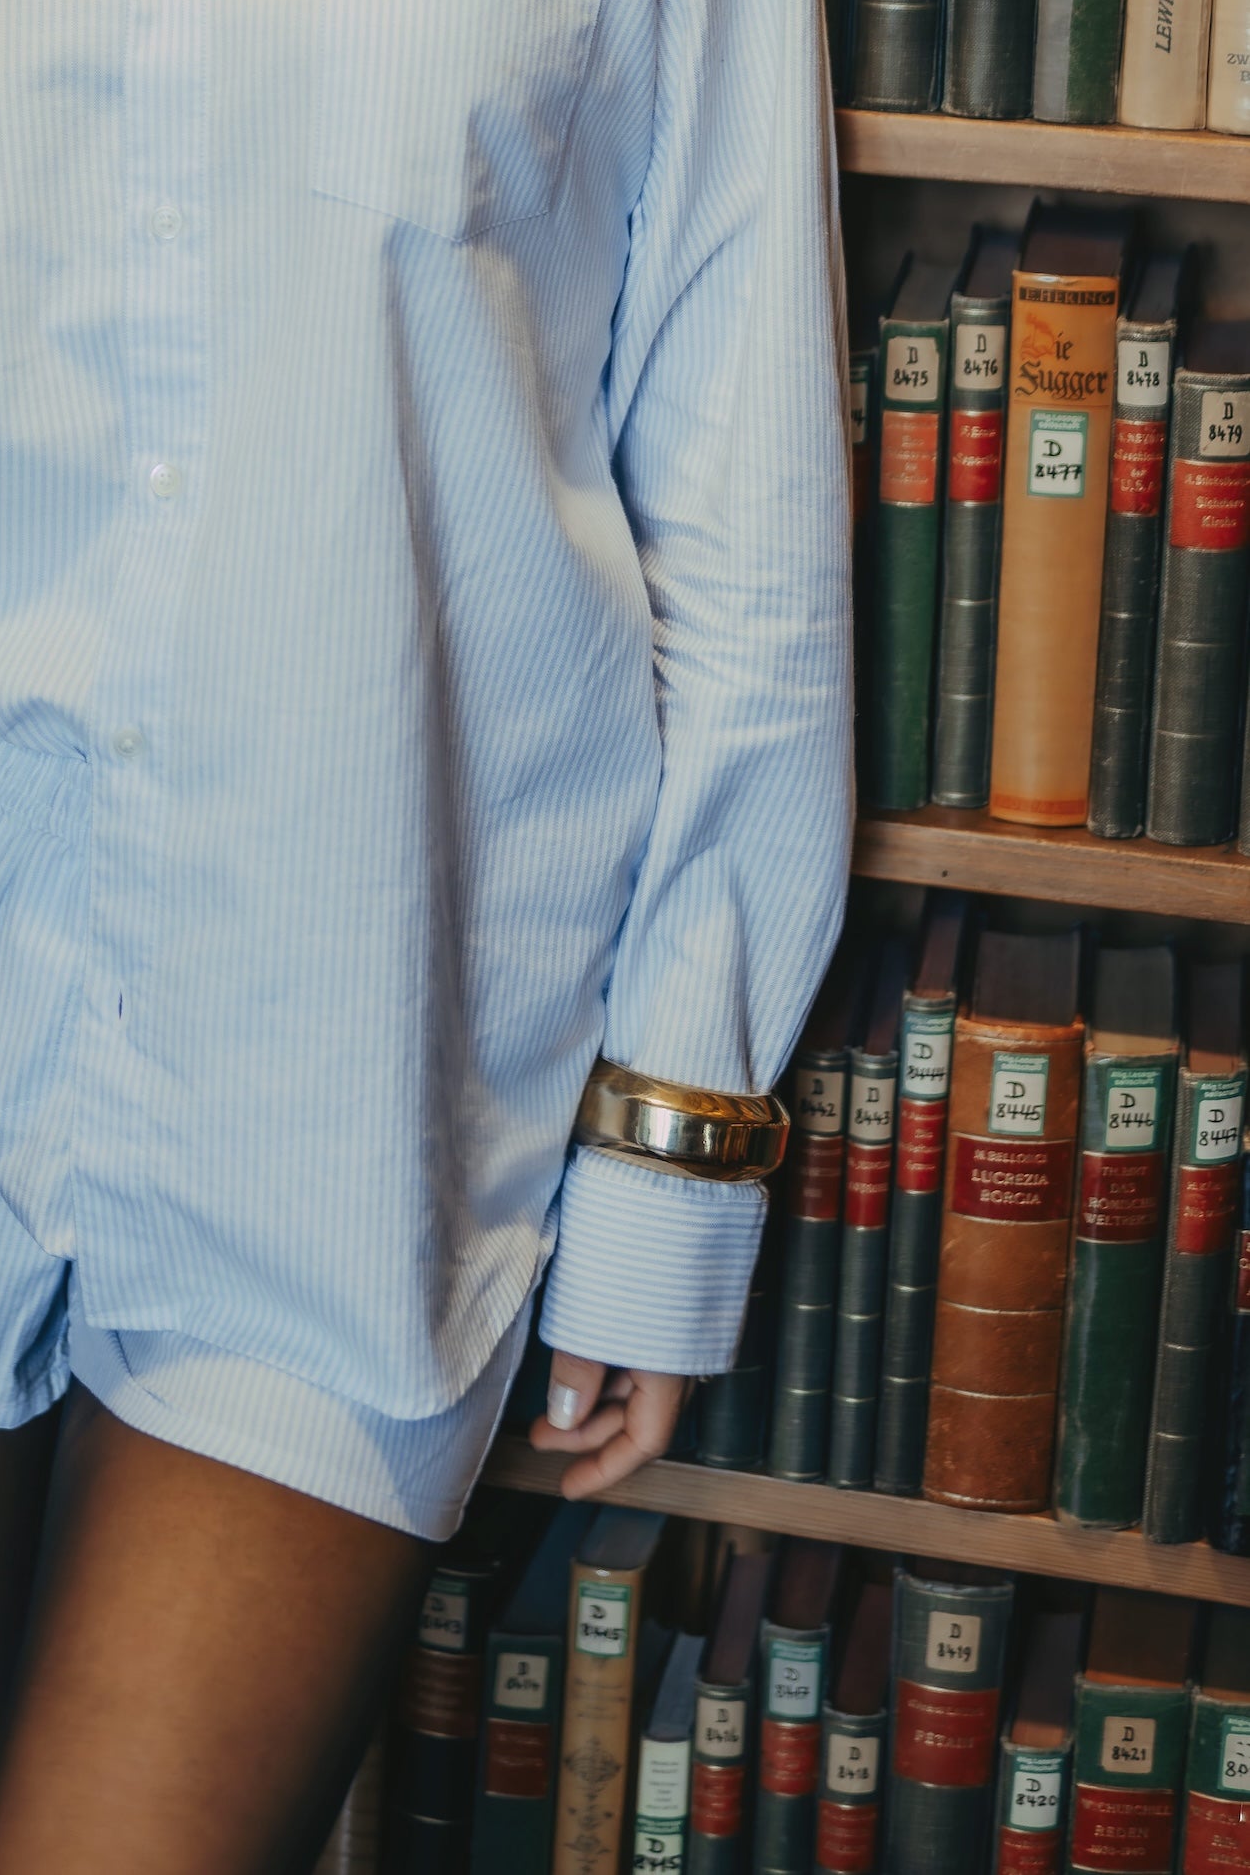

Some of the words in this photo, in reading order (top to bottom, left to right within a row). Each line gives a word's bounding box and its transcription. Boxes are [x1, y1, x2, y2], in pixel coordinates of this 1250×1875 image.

[975, 333, 988, 354] D
[906, 346, 918, 366] D
[1138, 351, 1148, 368] D
[963, 358, 999, 379] 8476
[893, 368, 929, 387] 8475
[1014, 361, 1109, 401] Fugger
[1126, 371, 1160, 387] 8478
[1222, 402, 1234, 420] D
[1208, 425, 1243, 444] 8479
[1042, 440, 1062, 457] D
[1033, 464, 1082, 481] 8477
[913, 1042, 934, 1060] D
[866, 1086, 880, 1103] D
[1005, 1081, 1026, 1099] D
[1119, 1092, 1136, 1109] D
[854, 1107, 891, 1125] 8443
[996, 1103, 1045, 1121] 8445
[1208, 1108, 1225, 1124] D
[971, 1168, 1050, 1187] LUCREZIA
[979, 1188, 1043, 1206] BORGIA
[949, 1622, 962, 1639] D
[937, 1642, 972, 1662] 8419
[1122, 1726, 1135, 1742] D
[849, 1746, 861, 1761] D
[1111, 1746, 1147, 1761] 8421
[1025, 1778, 1042, 1794] D
[1015, 1793, 1059, 1809] 8420
[646, 1837, 665, 1853] D
